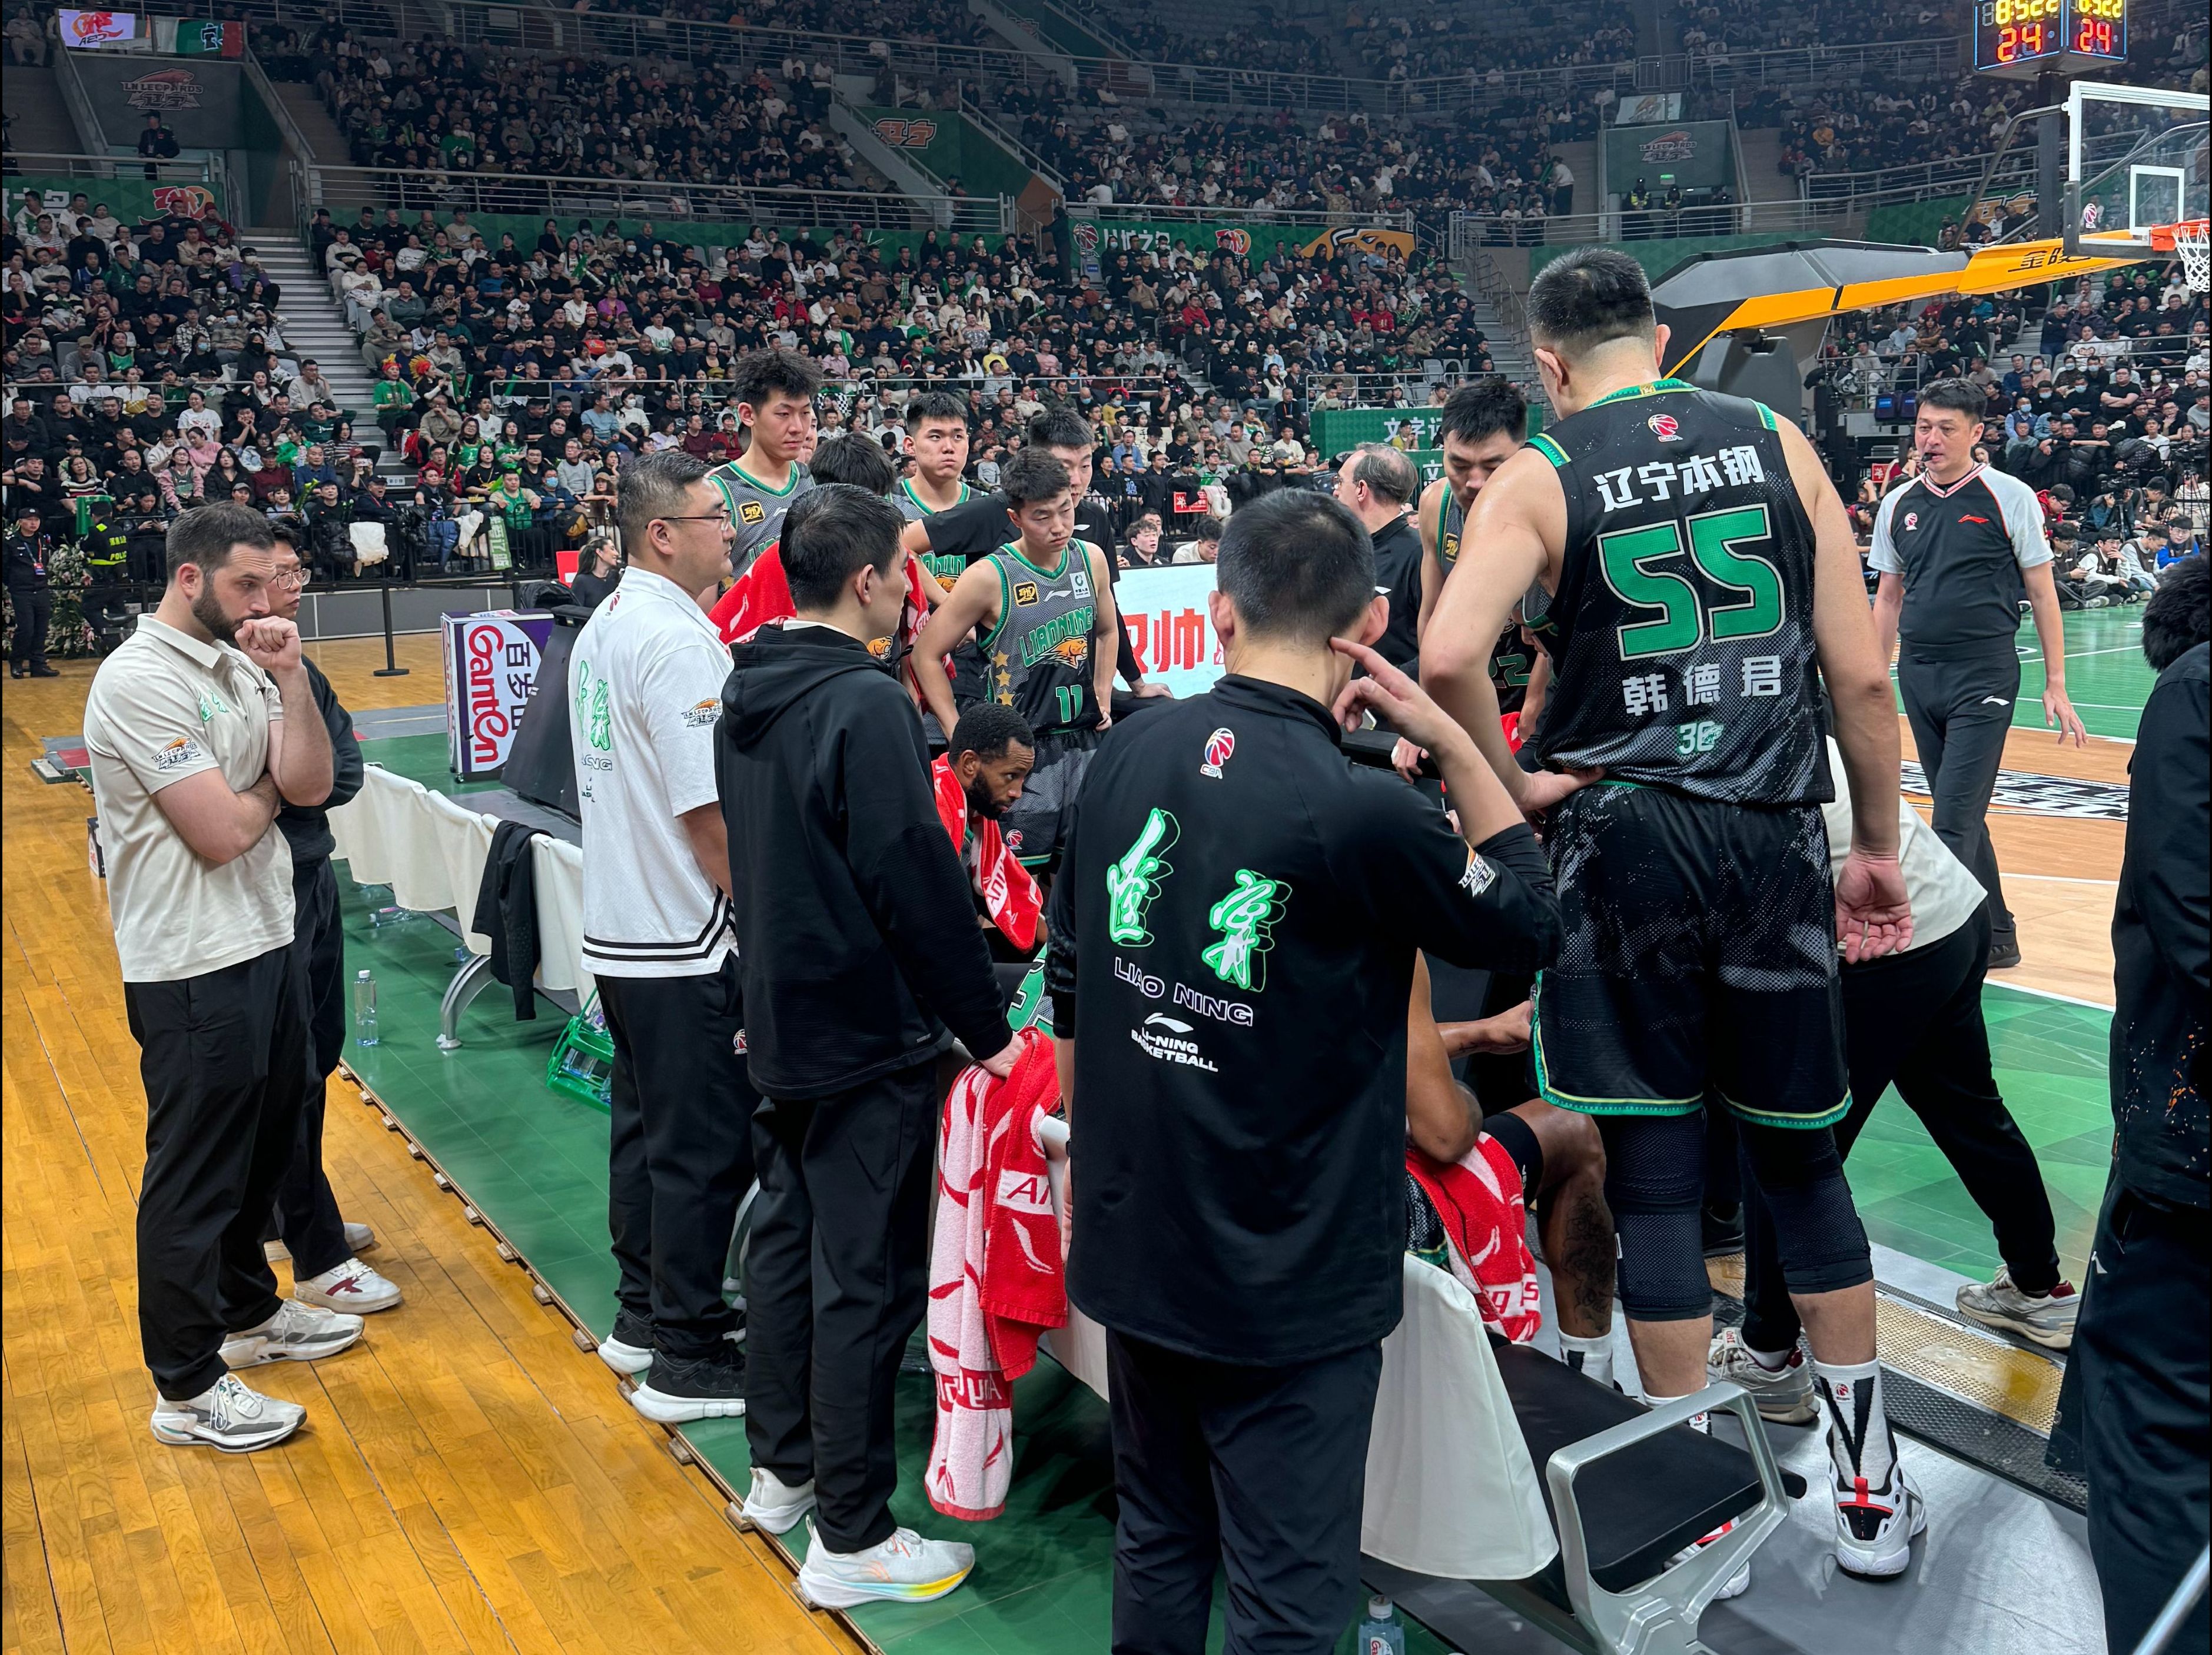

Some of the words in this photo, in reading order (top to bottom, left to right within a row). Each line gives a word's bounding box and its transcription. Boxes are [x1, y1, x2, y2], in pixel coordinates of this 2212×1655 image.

[1997, 23, 2042, 62] 24
[2080, 18, 2111, 53] 24
[1593, 446, 1765, 513] 辽宁本钢
[1597, 503, 1786, 662] 55
[1019, 605, 1094, 667] LIAONING
[1056, 684, 1083, 723] 11
[1622, 655, 1781, 716] 韩德君
[1114, 956, 1165, 999] LIAO
[1173, 982, 1254, 1027] NING
[1131, 1029, 1218, 1072] BASKETBALL
[1141, 1026, 1198, 1055] LI-NING
